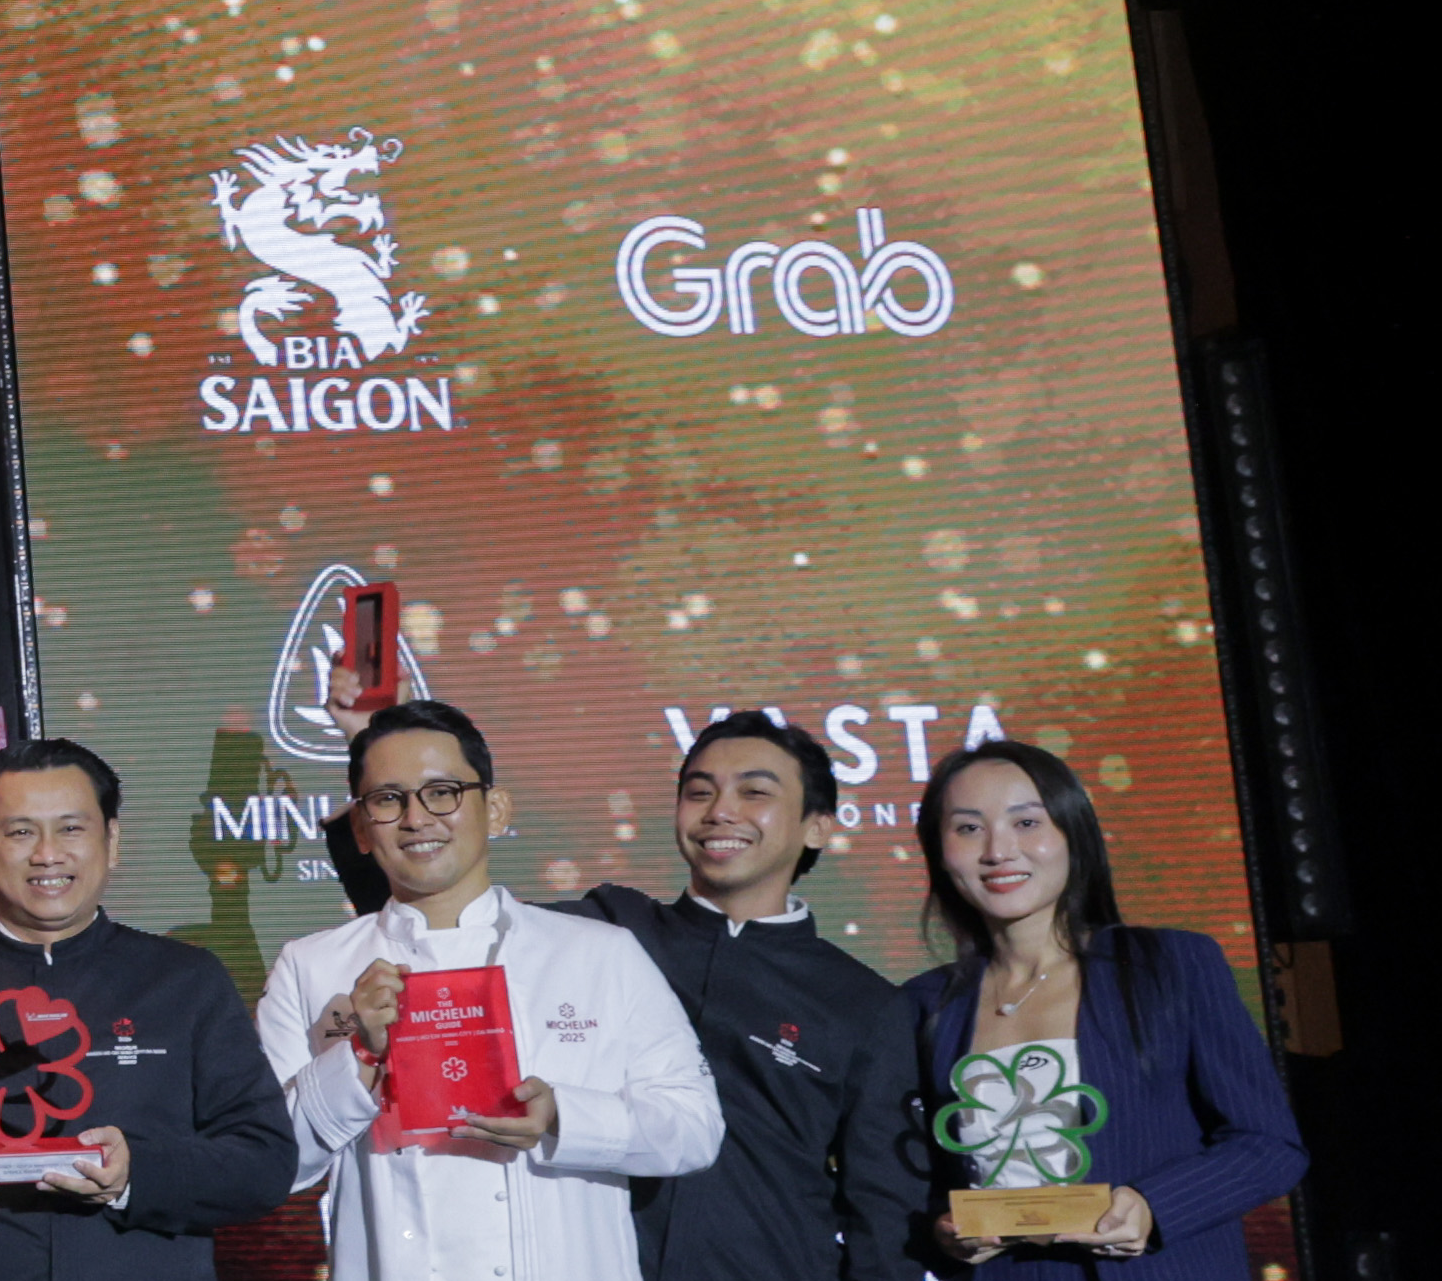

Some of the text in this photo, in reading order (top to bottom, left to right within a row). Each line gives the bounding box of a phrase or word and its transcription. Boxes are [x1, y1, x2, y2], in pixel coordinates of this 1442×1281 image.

[615, 206, 955, 338] Grab
[284, 336, 362, 369] BIA
[200, 375, 453, 432] SAIGON
[410, 1006, 484, 1023] MICHELIN
[435, 1021, 461, 1029] GUIDE
[546, 1019, 598, 1030] MICHELIN
[559, 1033, 586, 1042] 2025
